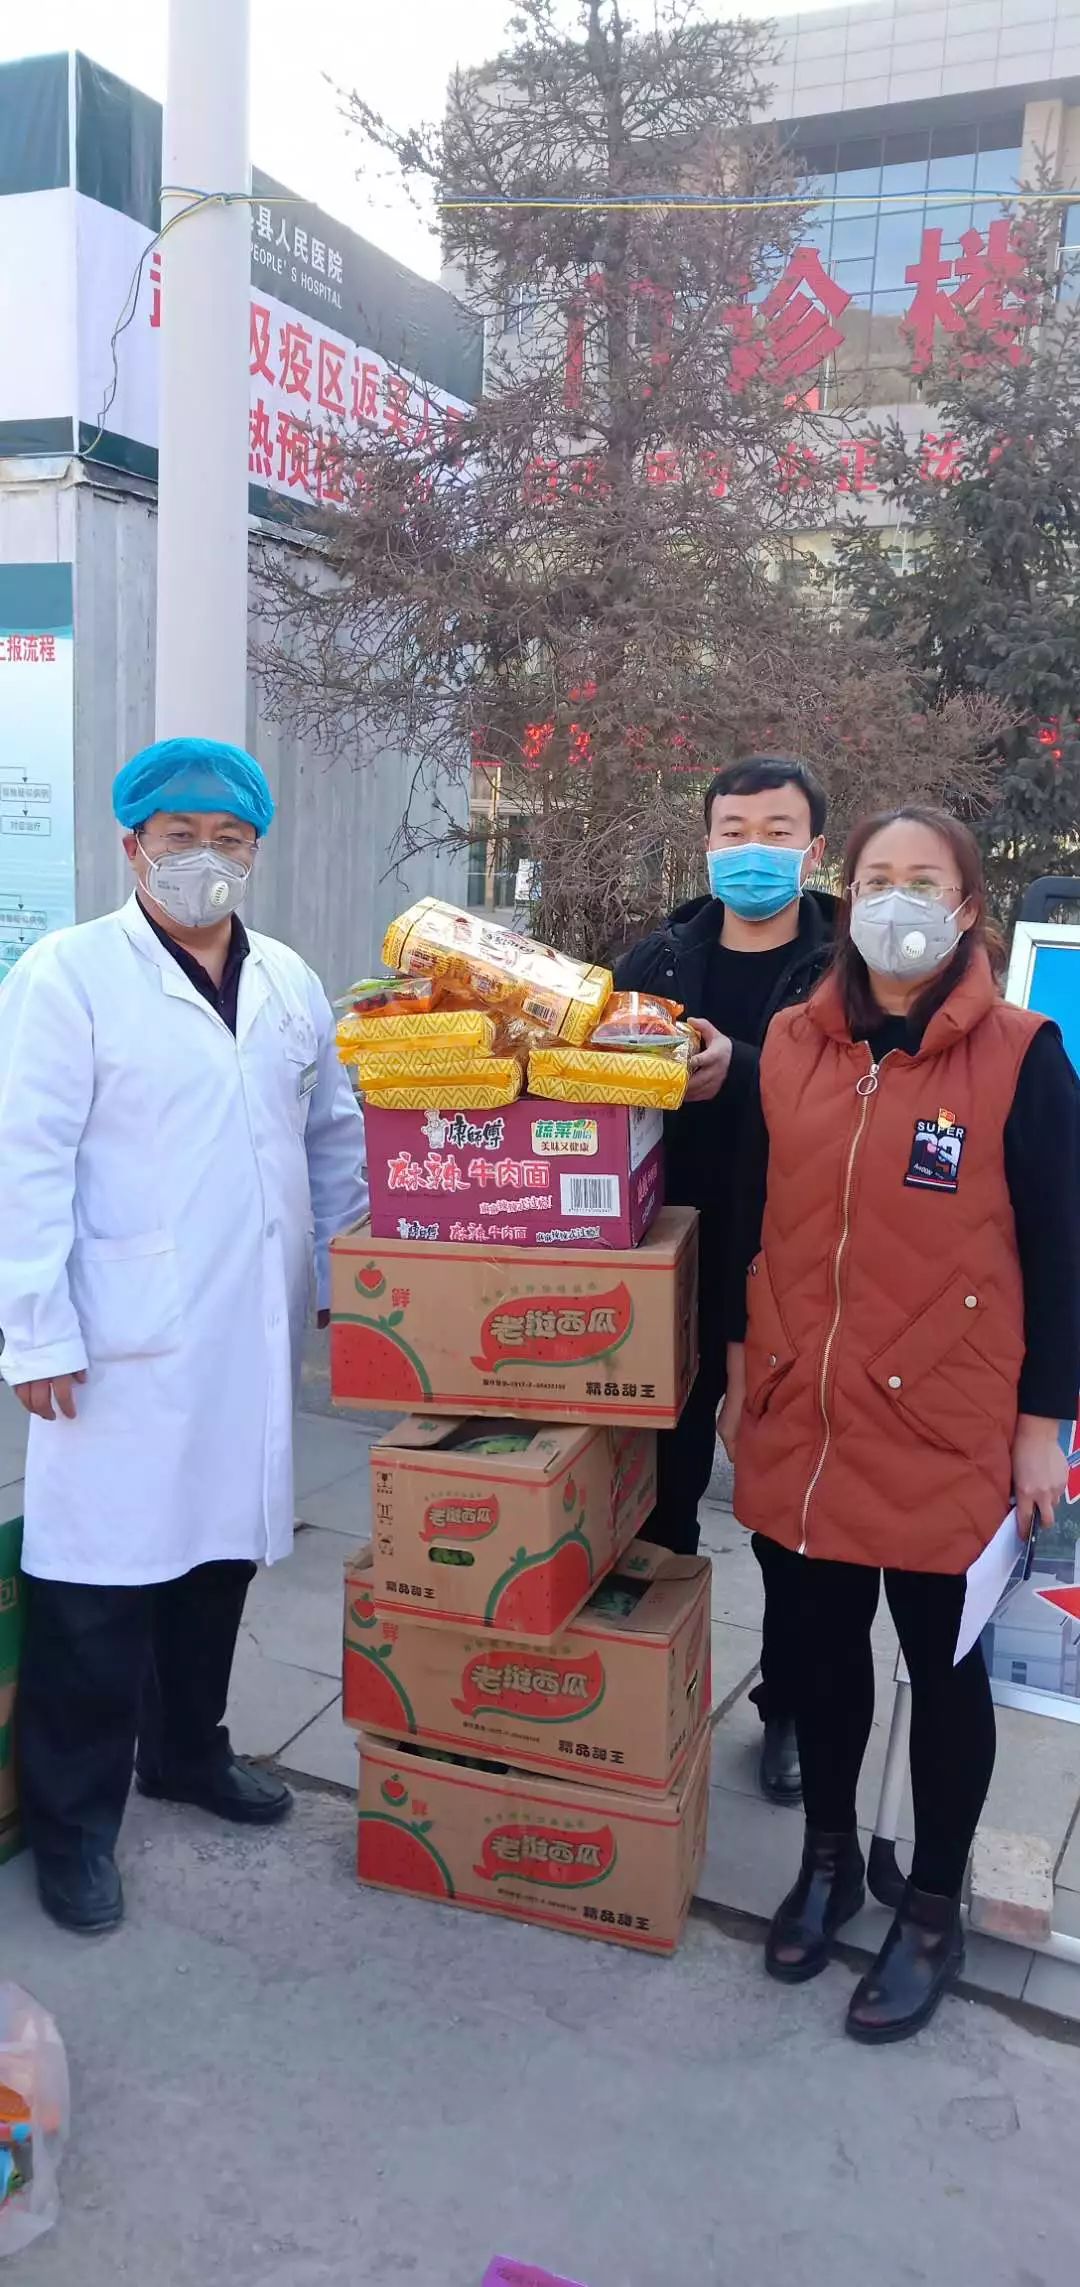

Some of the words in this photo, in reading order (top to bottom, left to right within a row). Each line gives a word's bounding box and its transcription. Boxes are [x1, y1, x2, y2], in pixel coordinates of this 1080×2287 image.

[301, 271, 342, 310] HOSPITAL
[917, 1121, 964, 1138] SUPER
[387, 1151, 552, 1192] 麻辣牛肉面
[586, 1381, 656, 1399] 精品甜王
[558, 1739, 625, 1764] 精品甜王
[582, 1905, 651, 1932] 精品甜王
